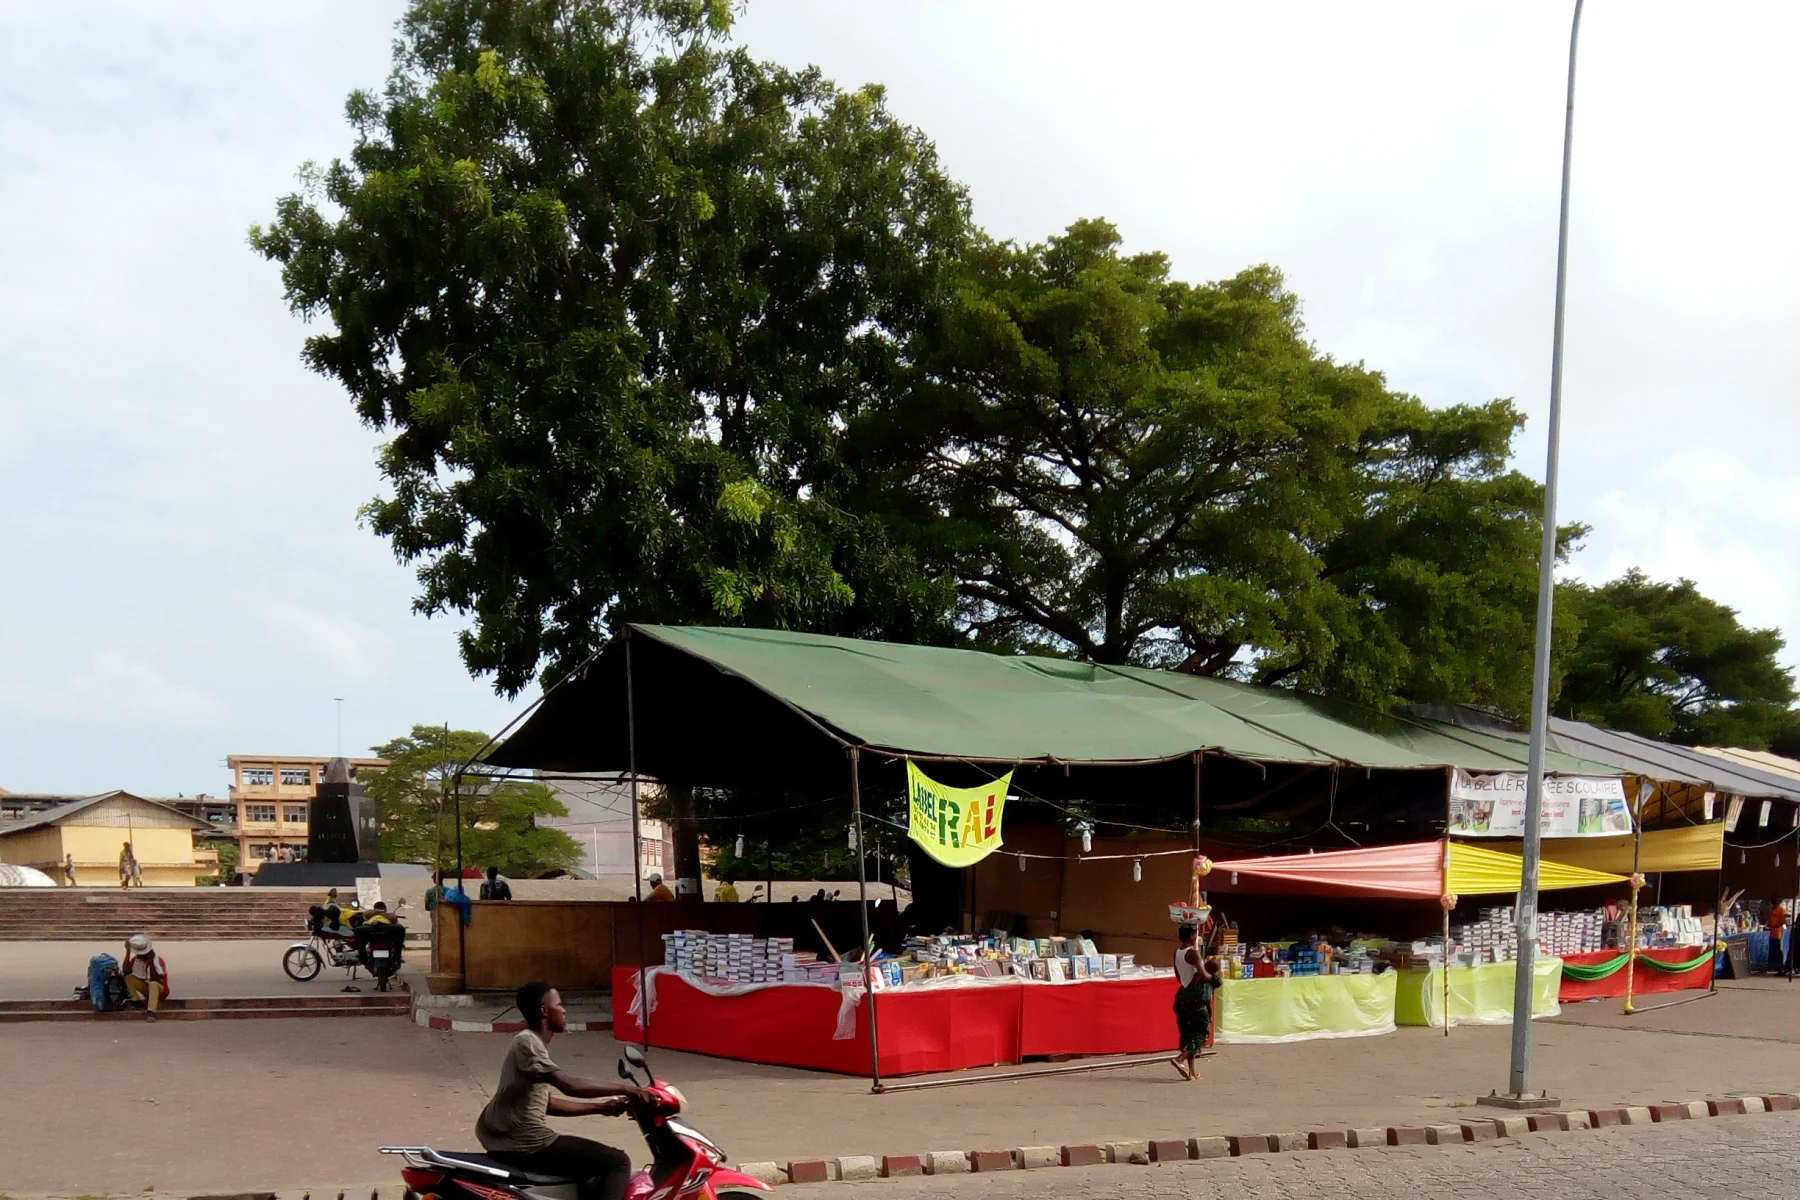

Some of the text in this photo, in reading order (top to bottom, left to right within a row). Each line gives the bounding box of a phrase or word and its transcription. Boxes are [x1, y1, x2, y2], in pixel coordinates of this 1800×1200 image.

[912, 775, 937, 823] LABEL
[1475, 779, 1513, 791] BELLE
[1566, 782, 1618, 794] SCOLAIRE
